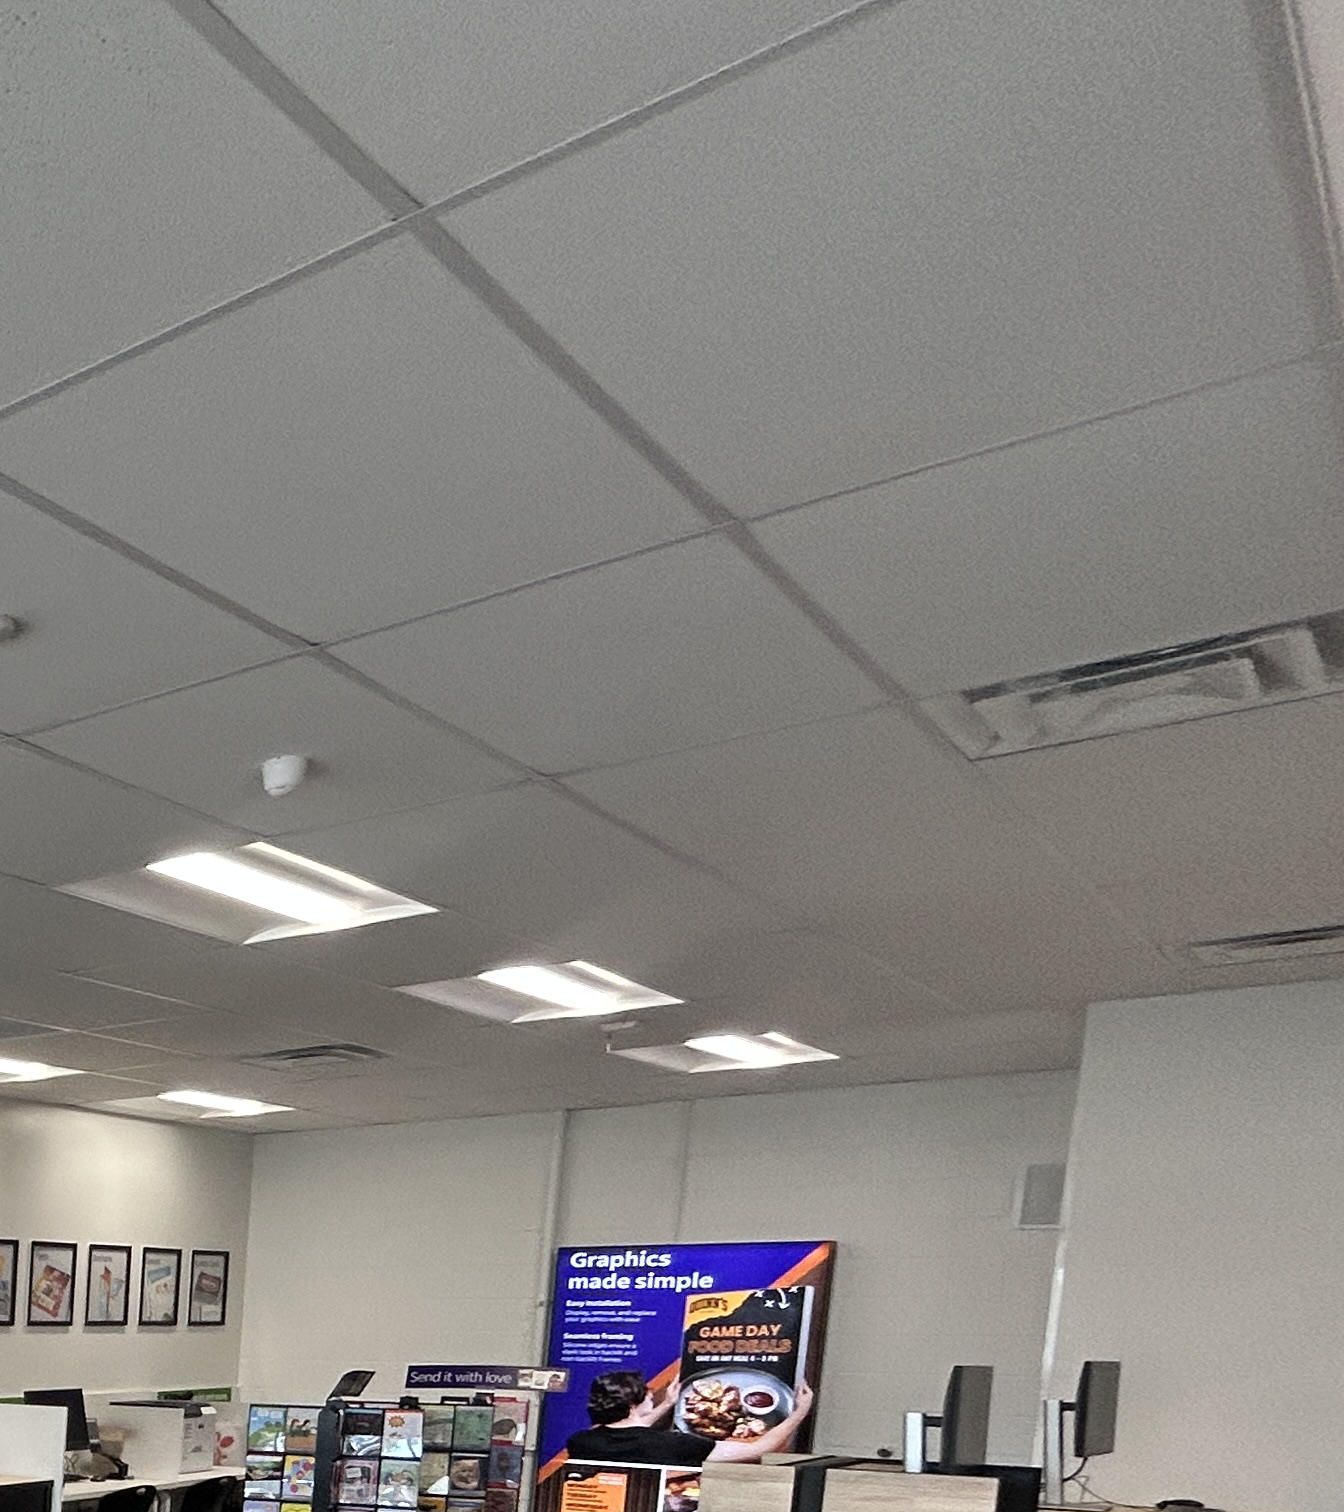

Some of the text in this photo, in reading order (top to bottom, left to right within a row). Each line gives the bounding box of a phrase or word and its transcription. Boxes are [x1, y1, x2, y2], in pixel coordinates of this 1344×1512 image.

[569, 1250, 672, 1272] Graphics
[567, 1271, 714, 1293] made simple
[699, 1324, 782, 1338] GAME DAY
[687, 1338, 793, 1354] FOOD DEALS
[409, 1370, 513, 1384] Send it with love
